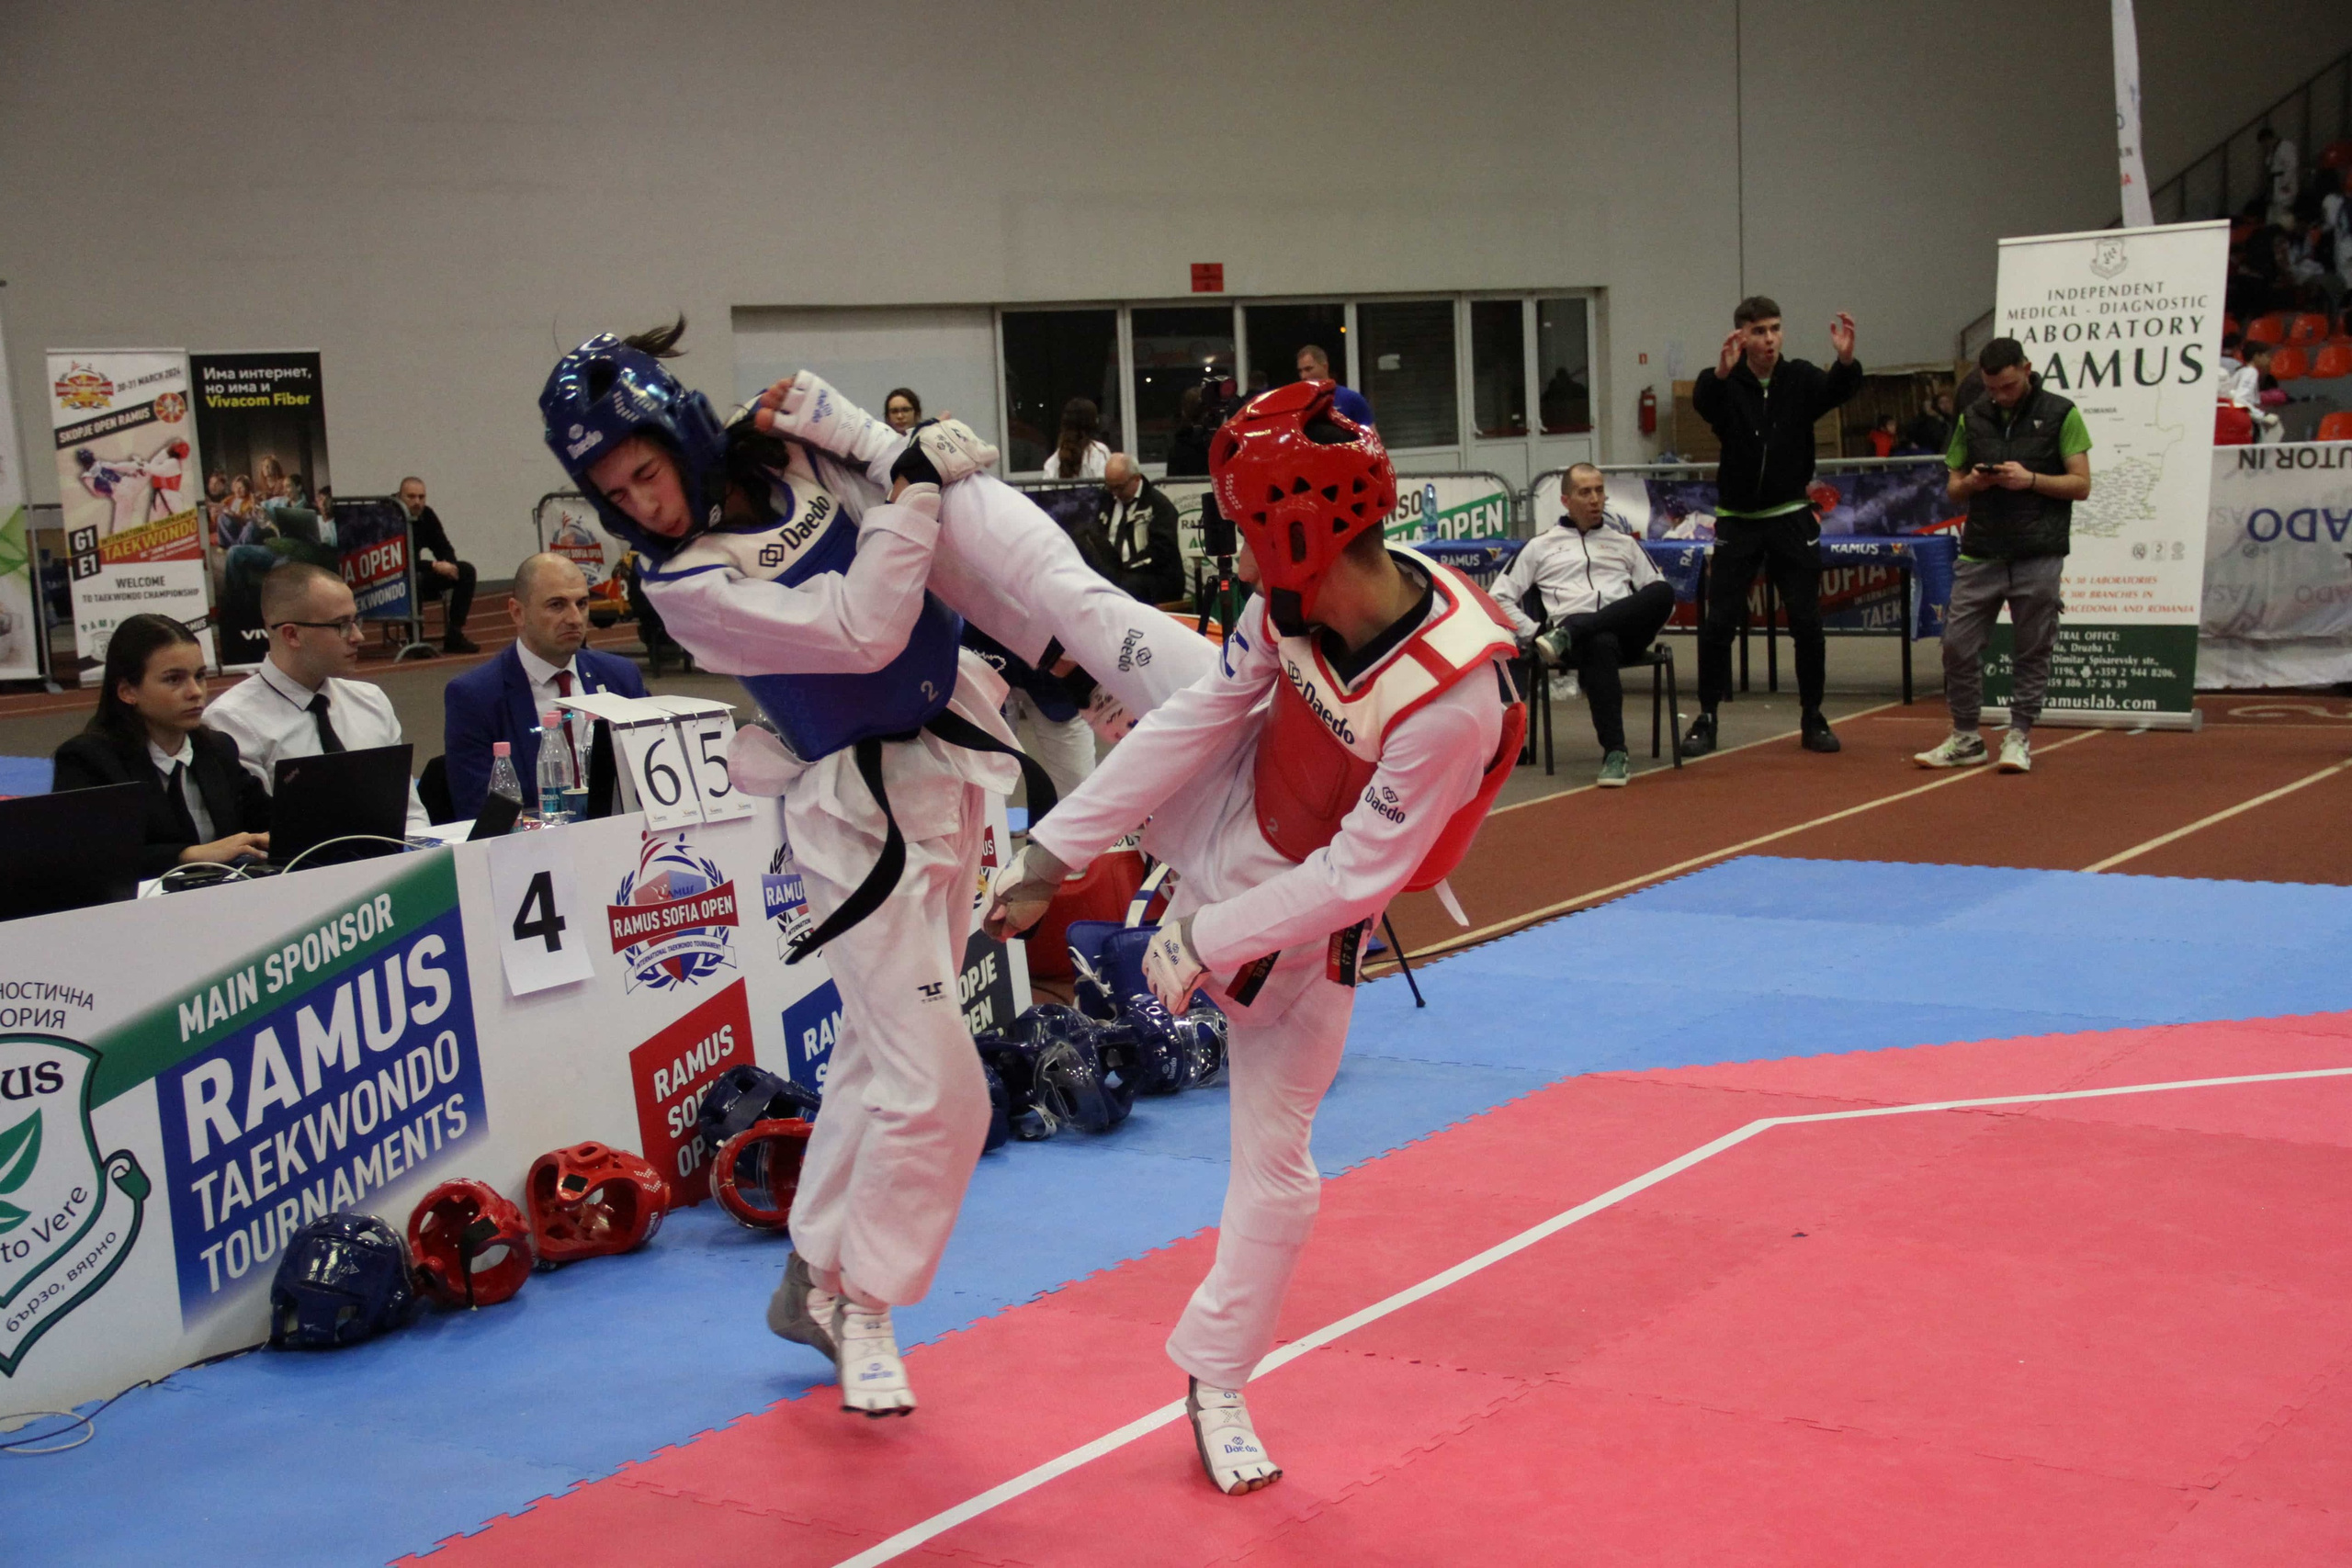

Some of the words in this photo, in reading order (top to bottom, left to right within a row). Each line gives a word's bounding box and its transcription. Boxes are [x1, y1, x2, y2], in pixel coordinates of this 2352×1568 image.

[2048, 281, 2165, 301] INDEPENDENT
[2007, 305, 2076, 320] MEDICAL
[2099, 295, 2208, 314] DIAGNOSTIC
[138, 371, 164, 387] MARCH
[203, 367, 236, 380] Има
[239, 367, 312, 381] интернет,
[205, 384, 225, 394] но
[228, 383, 257, 393] има
[260, 382, 270, 392] и
[205, 395, 270, 408] Vivacom
[273, 392, 311, 405] Fiber
[59, 424, 94, 443] SKOPJE
[94, 418, 118, 434] OPEN
[118, 408, 151, 426] RAMUS
[779, 496, 831, 550] Daedo
[1438, 500, 1503, 540] OPEN
[74, 528, 95, 551] G1
[103, 519, 198, 561] TAEKWONDO
[78, 553, 98, 577] E1
[359, 541, 402, 579] OPEN
[1441, 554, 1480, 567] RAMUS
[116, 576, 166, 589] WELCOME
[144, 588, 199, 601] CHAMPIONSHIP
[2147, 604, 2194, 613] ROMANIA
[1117, 627, 1145, 672] Daedo
[2085, 631, 2120, 641] OFFICE:
[2052, 655, 2086, 665] Dimitar
[2089, 655, 2139, 667] Spisarevsky
[2131, 668, 2147, 678] 944
[1303, 681, 1355, 745] Daedo
[644, 738, 682, 807] 6
[699, 730, 733, 798] 5
[1364, 786, 1406, 825] Daedo
[512, 871, 567, 953] 4
[613, 911, 660, 938] RAMUS
[662, 904, 700, 929] SOFIA
[700, 895, 734, 920] OPEN
[178, 965, 259, 1043] MAIN
[265, 893, 395, 994] SPONSOR
[636, 948, 667, 969] INTERNATIONAL
[667, 941, 693, 954] TAEKWONDO
[693, 941, 722, 952] TOURNAMENT
[0, 1008, 66, 1029] ОРИЯ
[181, 933, 452, 1165] RAMUS
[653, 1024, 735, 1104] RAMUS
[1168, 1057, 1178, 1079] Daedo
[191, 1030, 459, 1232] TAEKWONDO
[199, 1093, 468, 1293] TOURNAMENTS
[0, 1239, 30, 1263] to
[31, 1187, 88, 1244] Vere
[6, 1283, 65, 1333] бързо,
[66, 1232, 117, 1281] вярно
